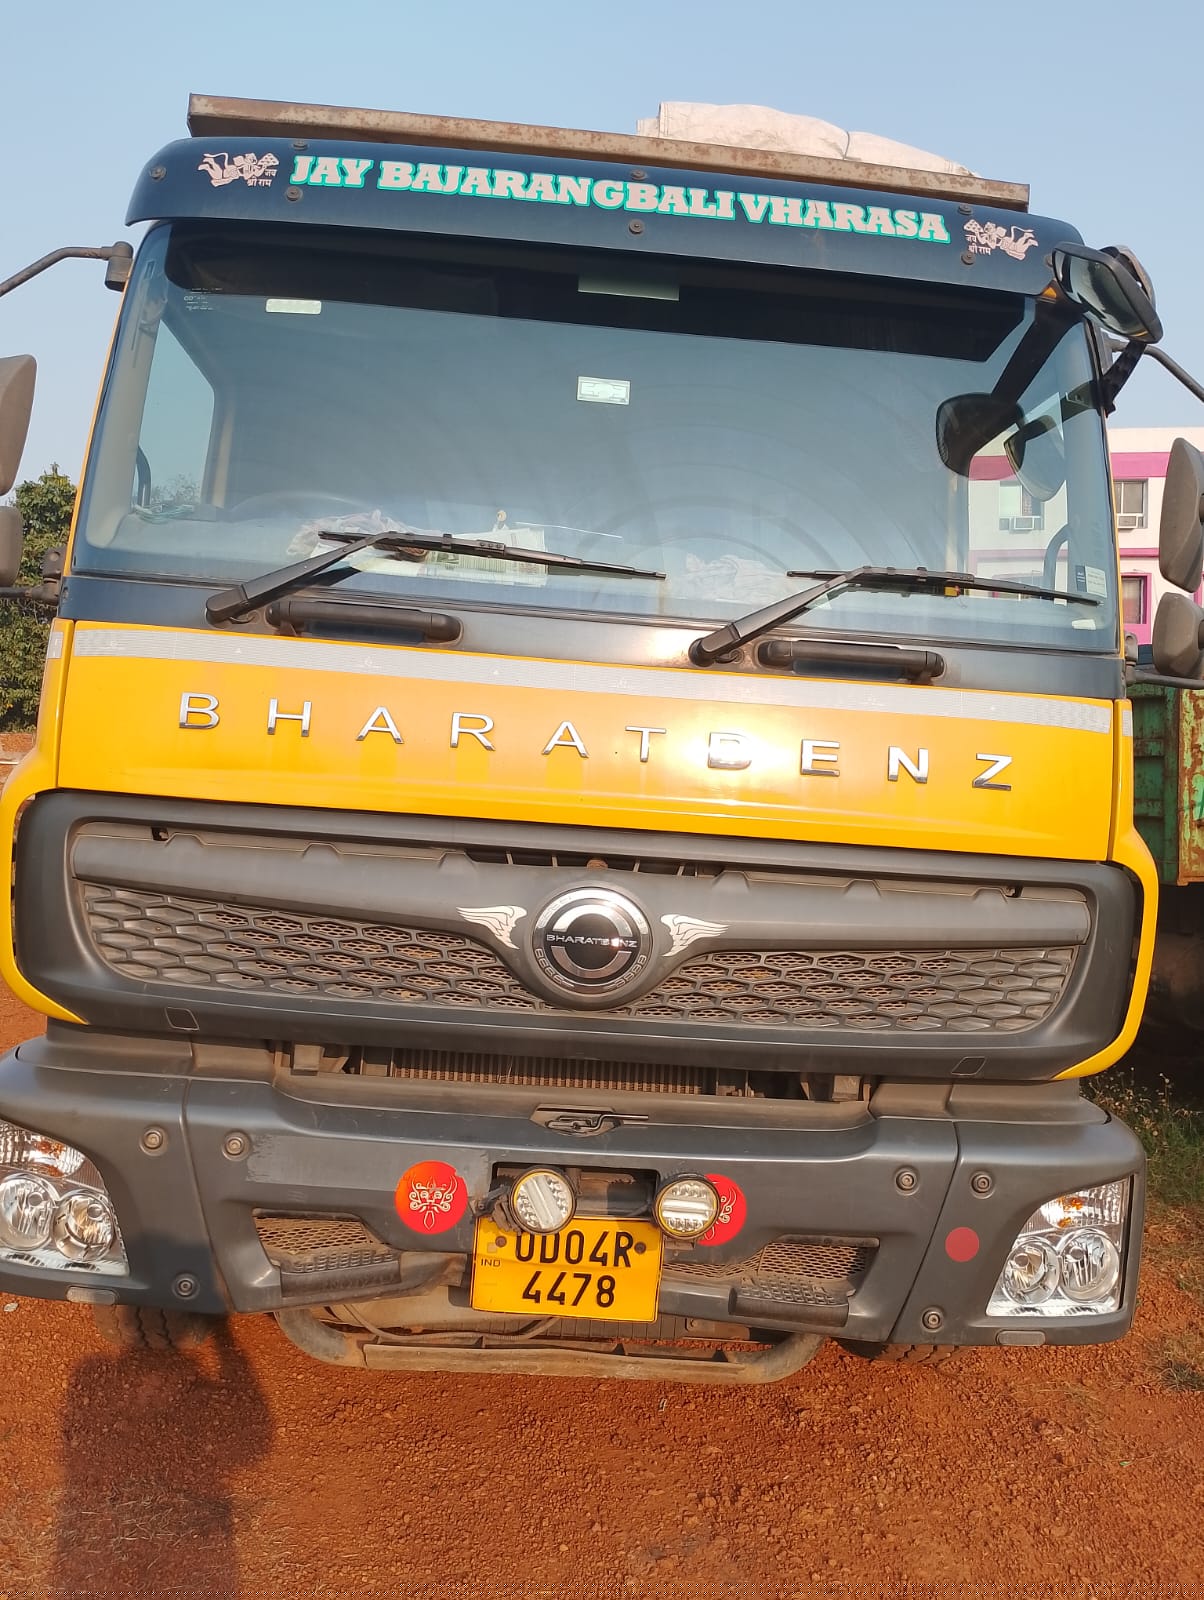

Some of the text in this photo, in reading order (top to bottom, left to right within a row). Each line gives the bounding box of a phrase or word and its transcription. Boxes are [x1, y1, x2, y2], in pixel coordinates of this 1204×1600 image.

[290, 156, 950, 244] JAY BAJARANGBALI VHARASA
[546, 934, 638, 948] BHARATBNZ
[480, 1258, 501, 1267] IND
[515, 1230, 634, 1268] OD04R
[522, 1271, 616, 1308] 4478
